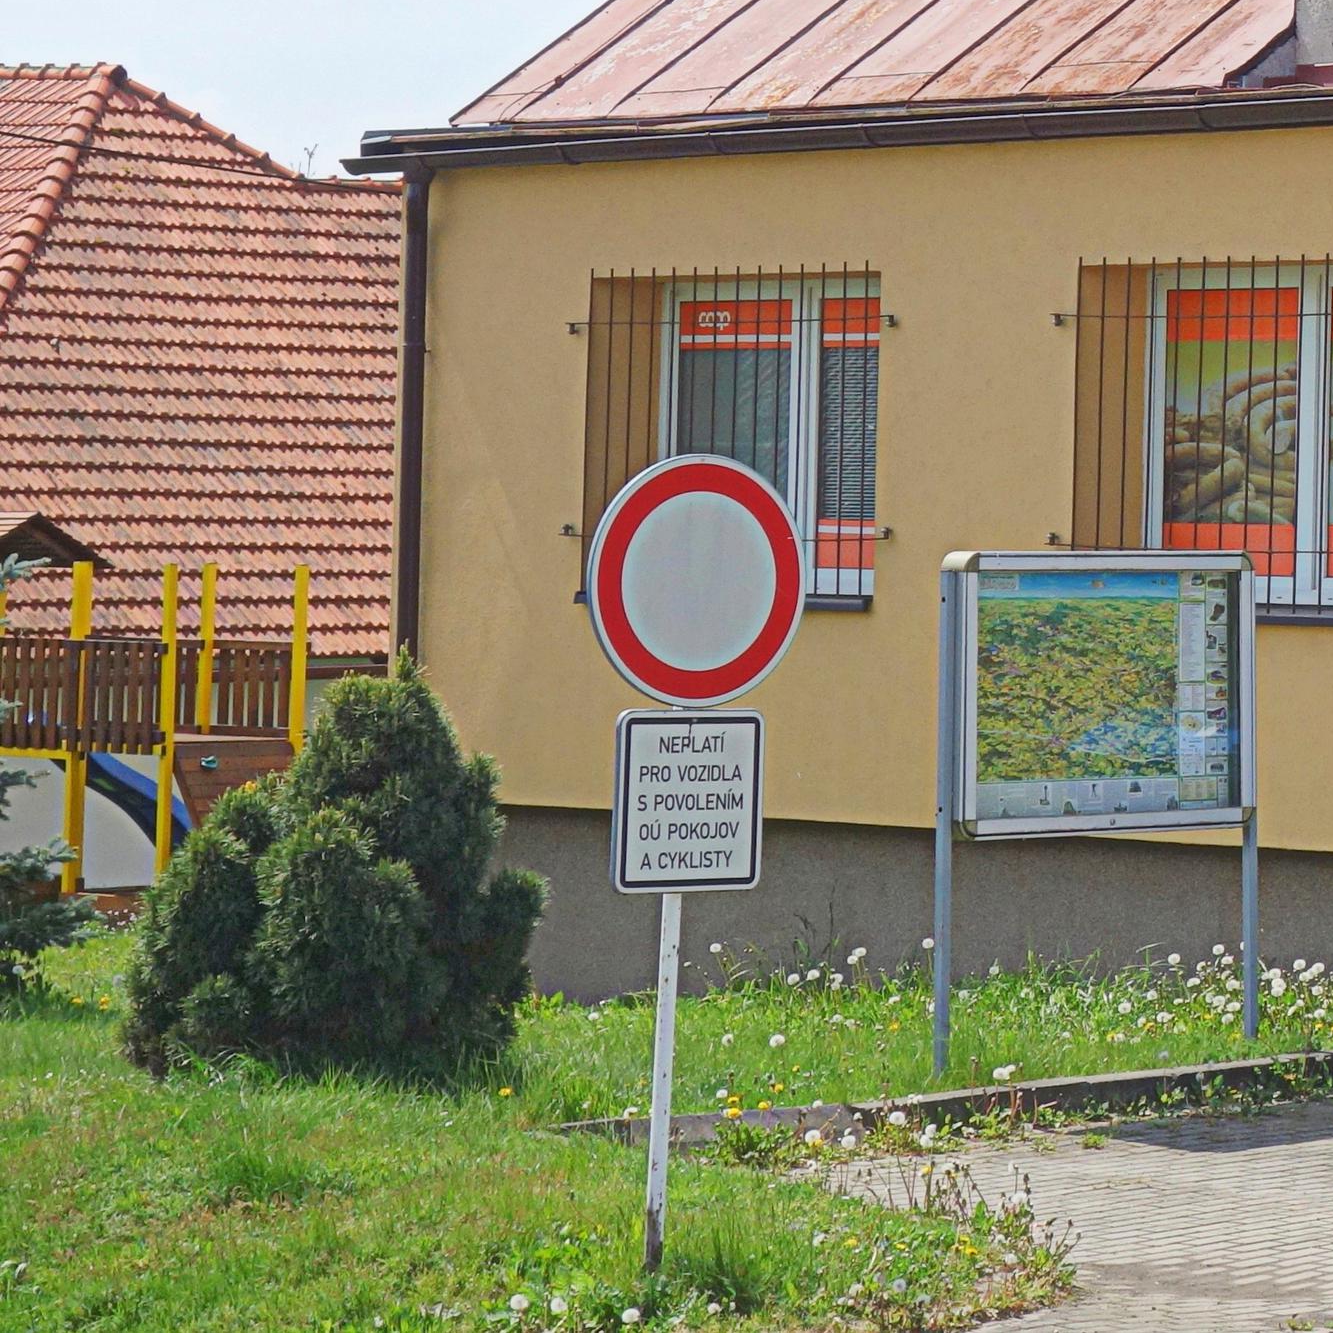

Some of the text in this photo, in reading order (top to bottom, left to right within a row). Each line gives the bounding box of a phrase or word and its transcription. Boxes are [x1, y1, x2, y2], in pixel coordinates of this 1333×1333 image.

[659, 731, 726, 753] NEPLATÍ
[639, 764, 742, 783] PRO VOZIDLA
[637, 788, 743, 811] S POVOLENÍM
[639, 819, 740, 841] OÚ POKOJOV
[640, 850, 733, 870] A CYKLISTY
